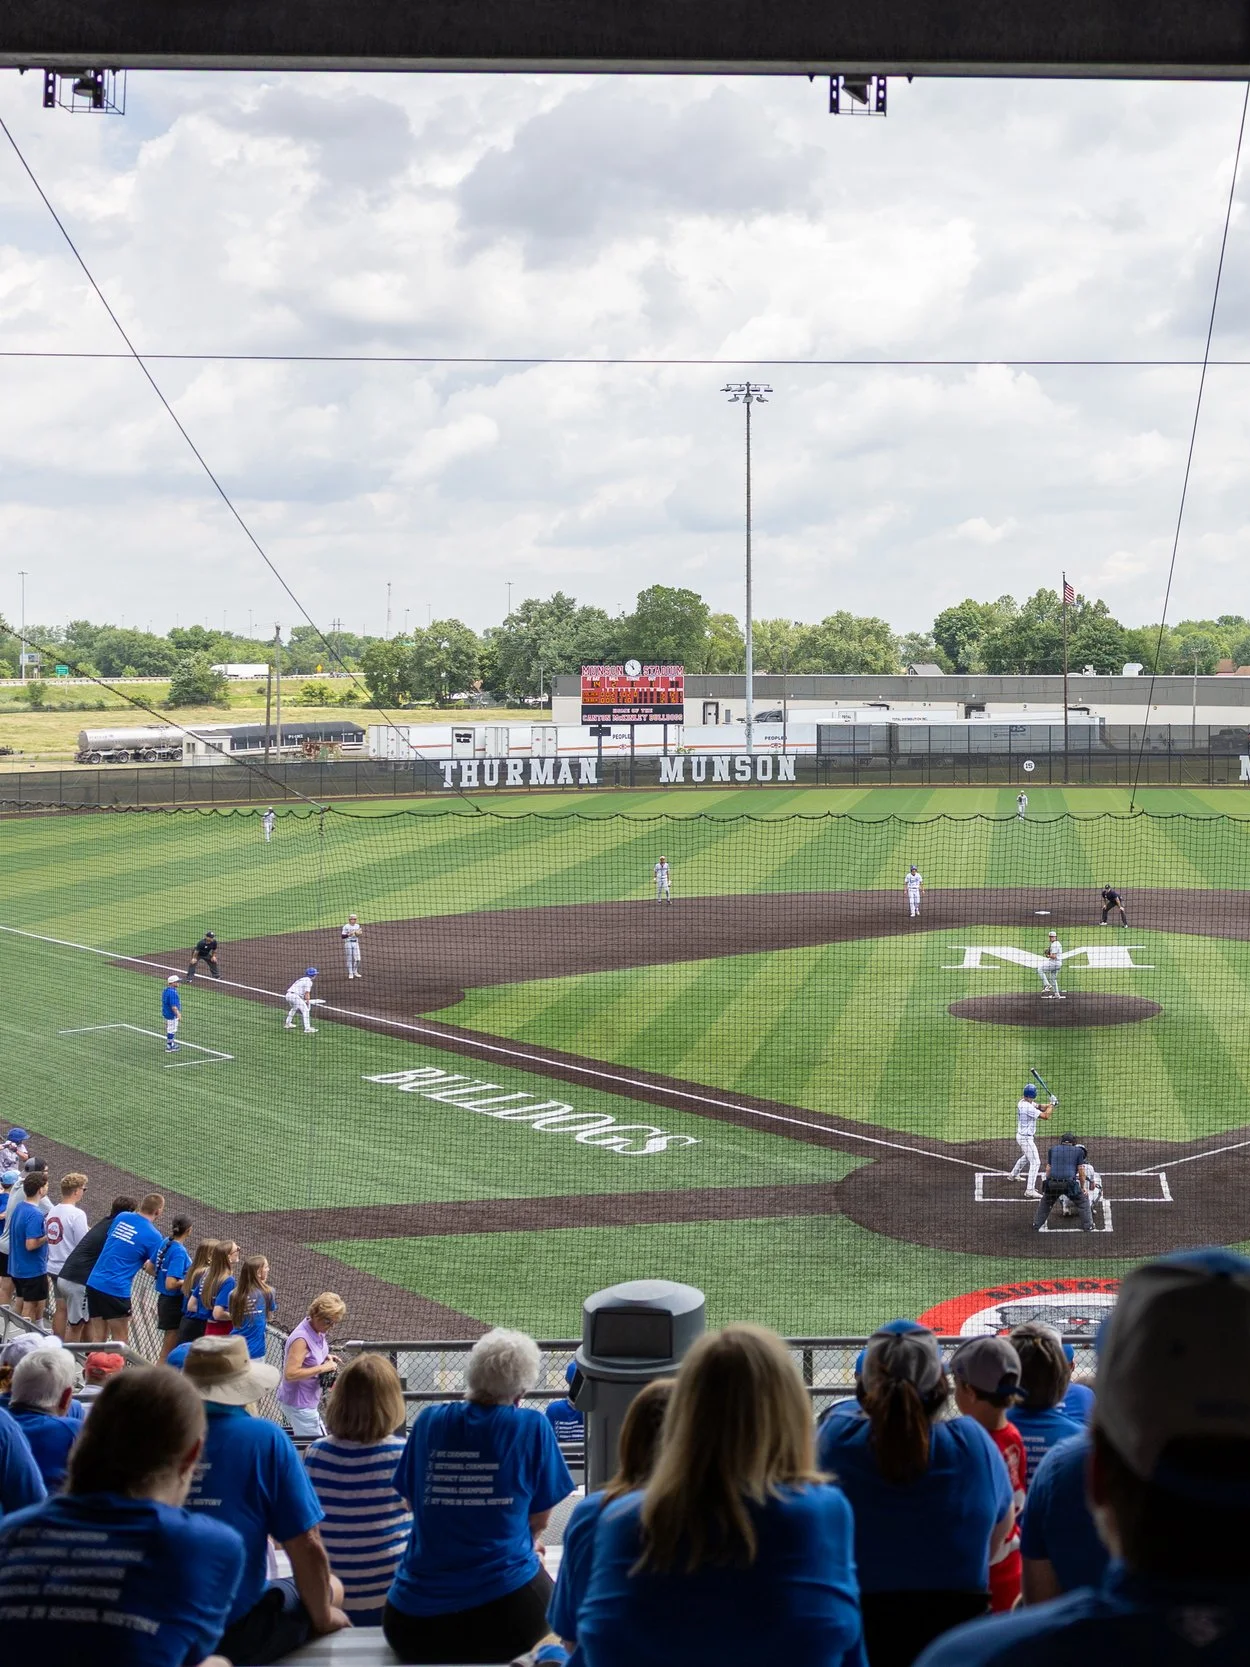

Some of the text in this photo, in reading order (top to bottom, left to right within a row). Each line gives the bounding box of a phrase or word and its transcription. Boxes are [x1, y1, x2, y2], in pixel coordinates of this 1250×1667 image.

[582, 665, 684, 676] MUNSON STADIUM
[440, 758, 598, 788] THURMAN
[660, 755, 796, 783] MUNSON
[361, 1066, 702, 1154] BULLDOGS
[447, 1450, 480, 1458] CHAMPIONS
[486, 1497, 514, 1505] HISTORY
[40, 1530, 108, 1542] CHAMPIONS
[70, 1548, 145, 1562] CHAMPIONS
[50, 1566, 126, 1580] CHAMPIONS
[42, 1584, 121, 1601] CHAMPIONS
[48, 1606, 100, 1623] SCHOOL
[101, 1610, 160, 1635] HISTORY
